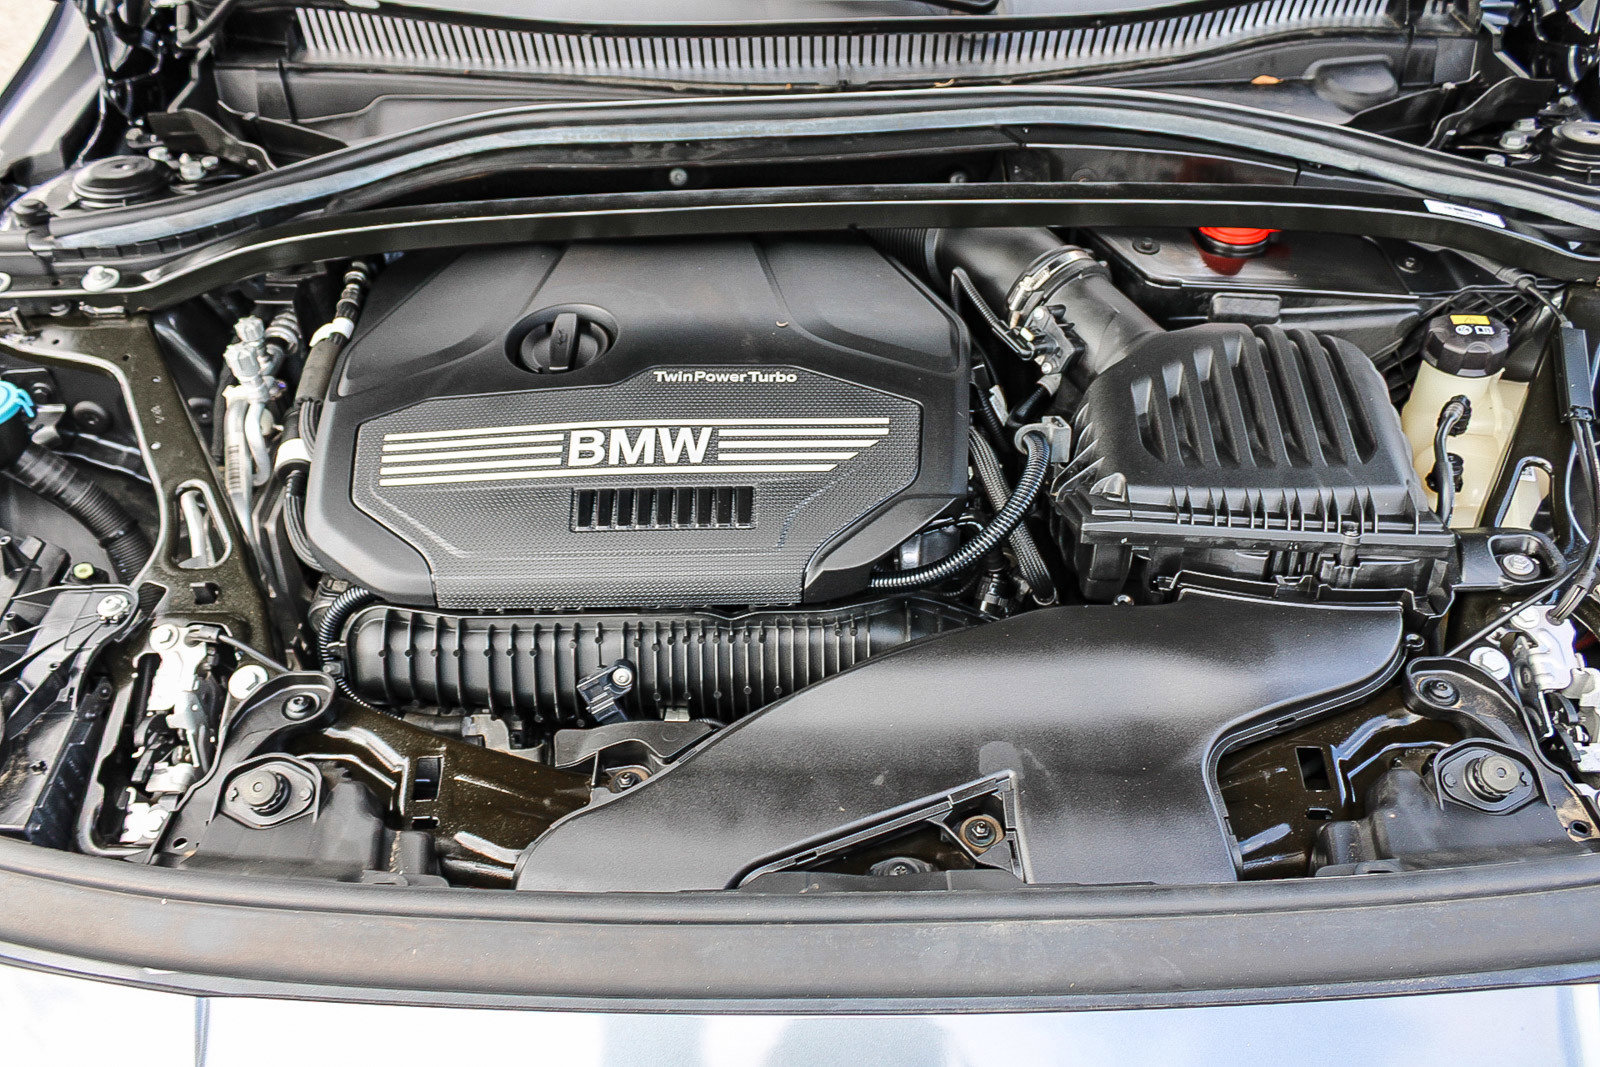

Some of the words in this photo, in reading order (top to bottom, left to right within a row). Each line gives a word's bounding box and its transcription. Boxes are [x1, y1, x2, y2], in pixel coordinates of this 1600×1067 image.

[653, 370, 747, 383] TwinPower
[748, 370, 798, 383] Turbo
[567, 427, 713, 467] BMW
